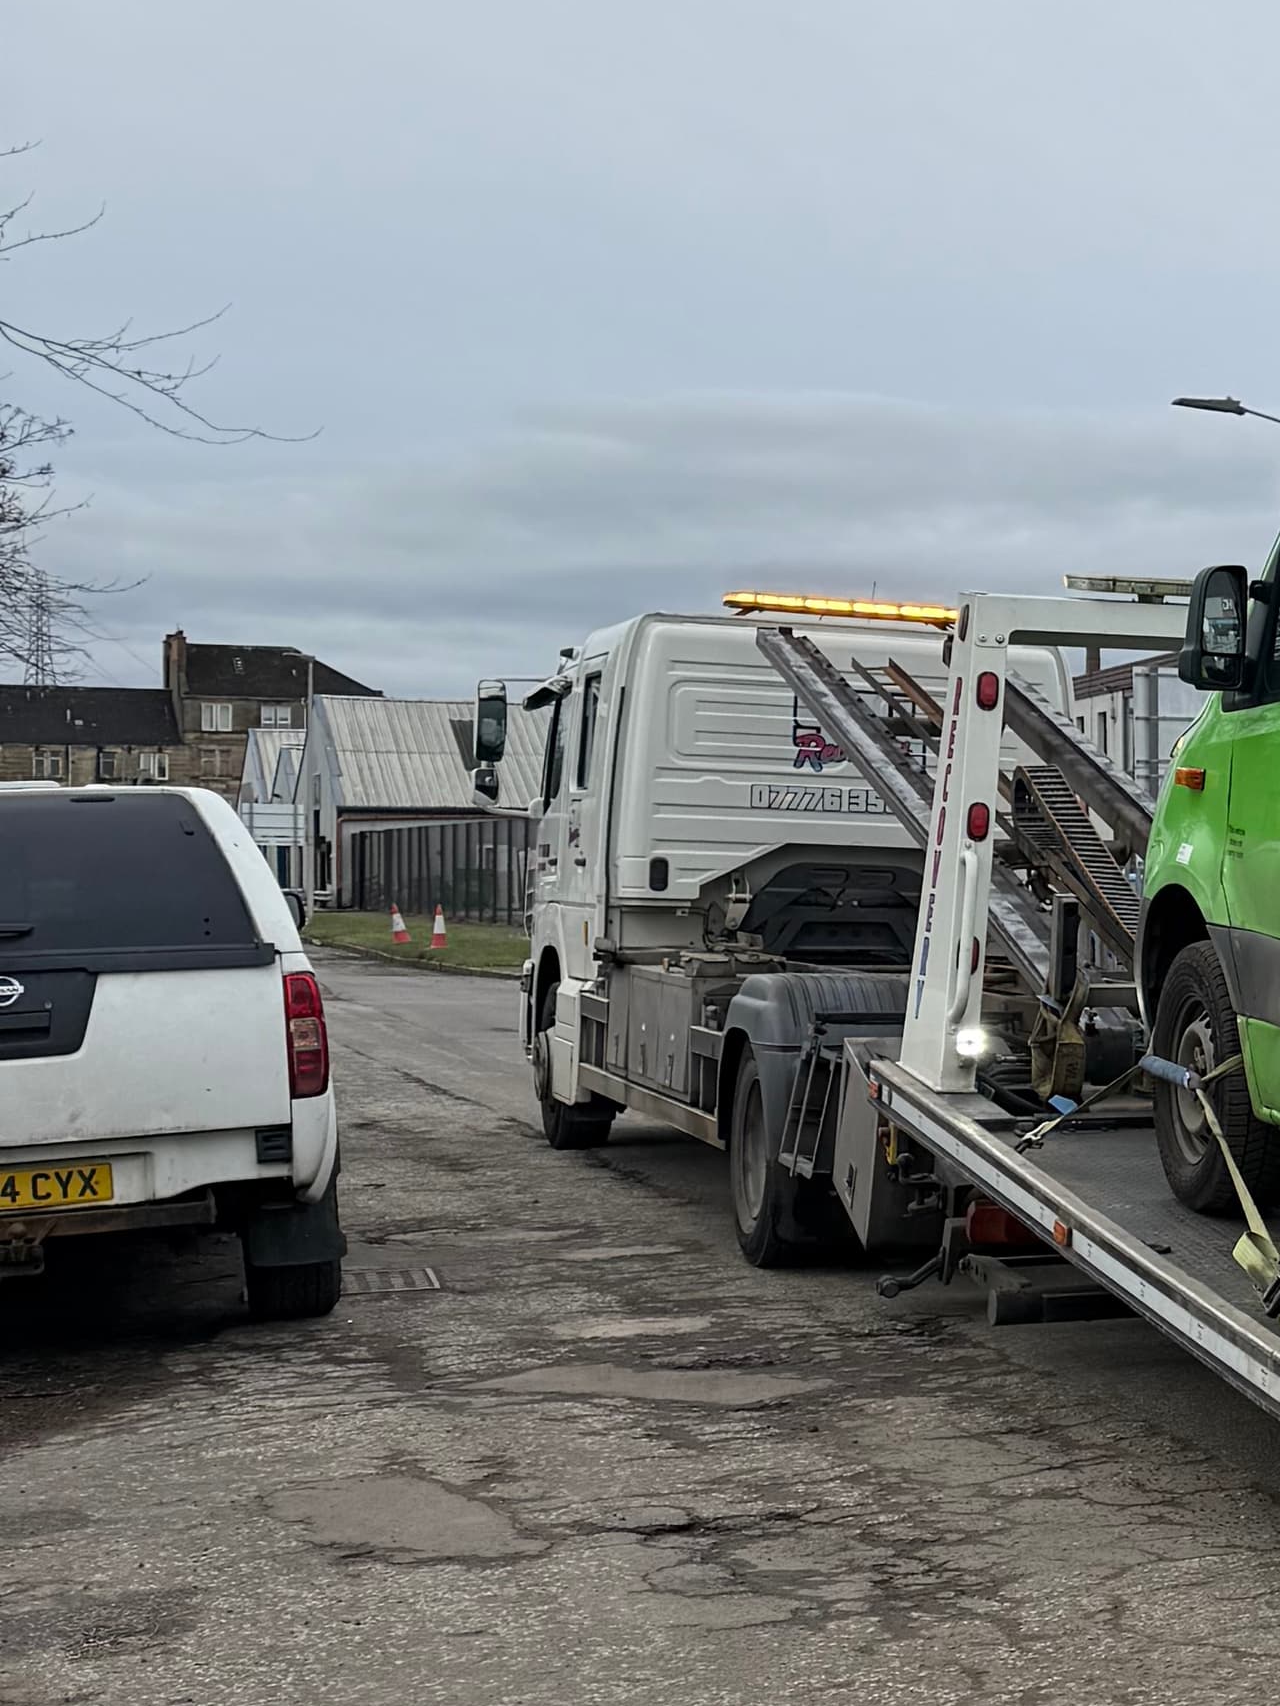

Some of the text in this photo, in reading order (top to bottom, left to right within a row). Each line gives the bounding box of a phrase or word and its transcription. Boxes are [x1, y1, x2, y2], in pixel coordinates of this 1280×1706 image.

[751, 783, 895, 815] 07776135
[914, 676, 963, 1020] RECOVERY
[31, 1168, 98, 1201] CYX
